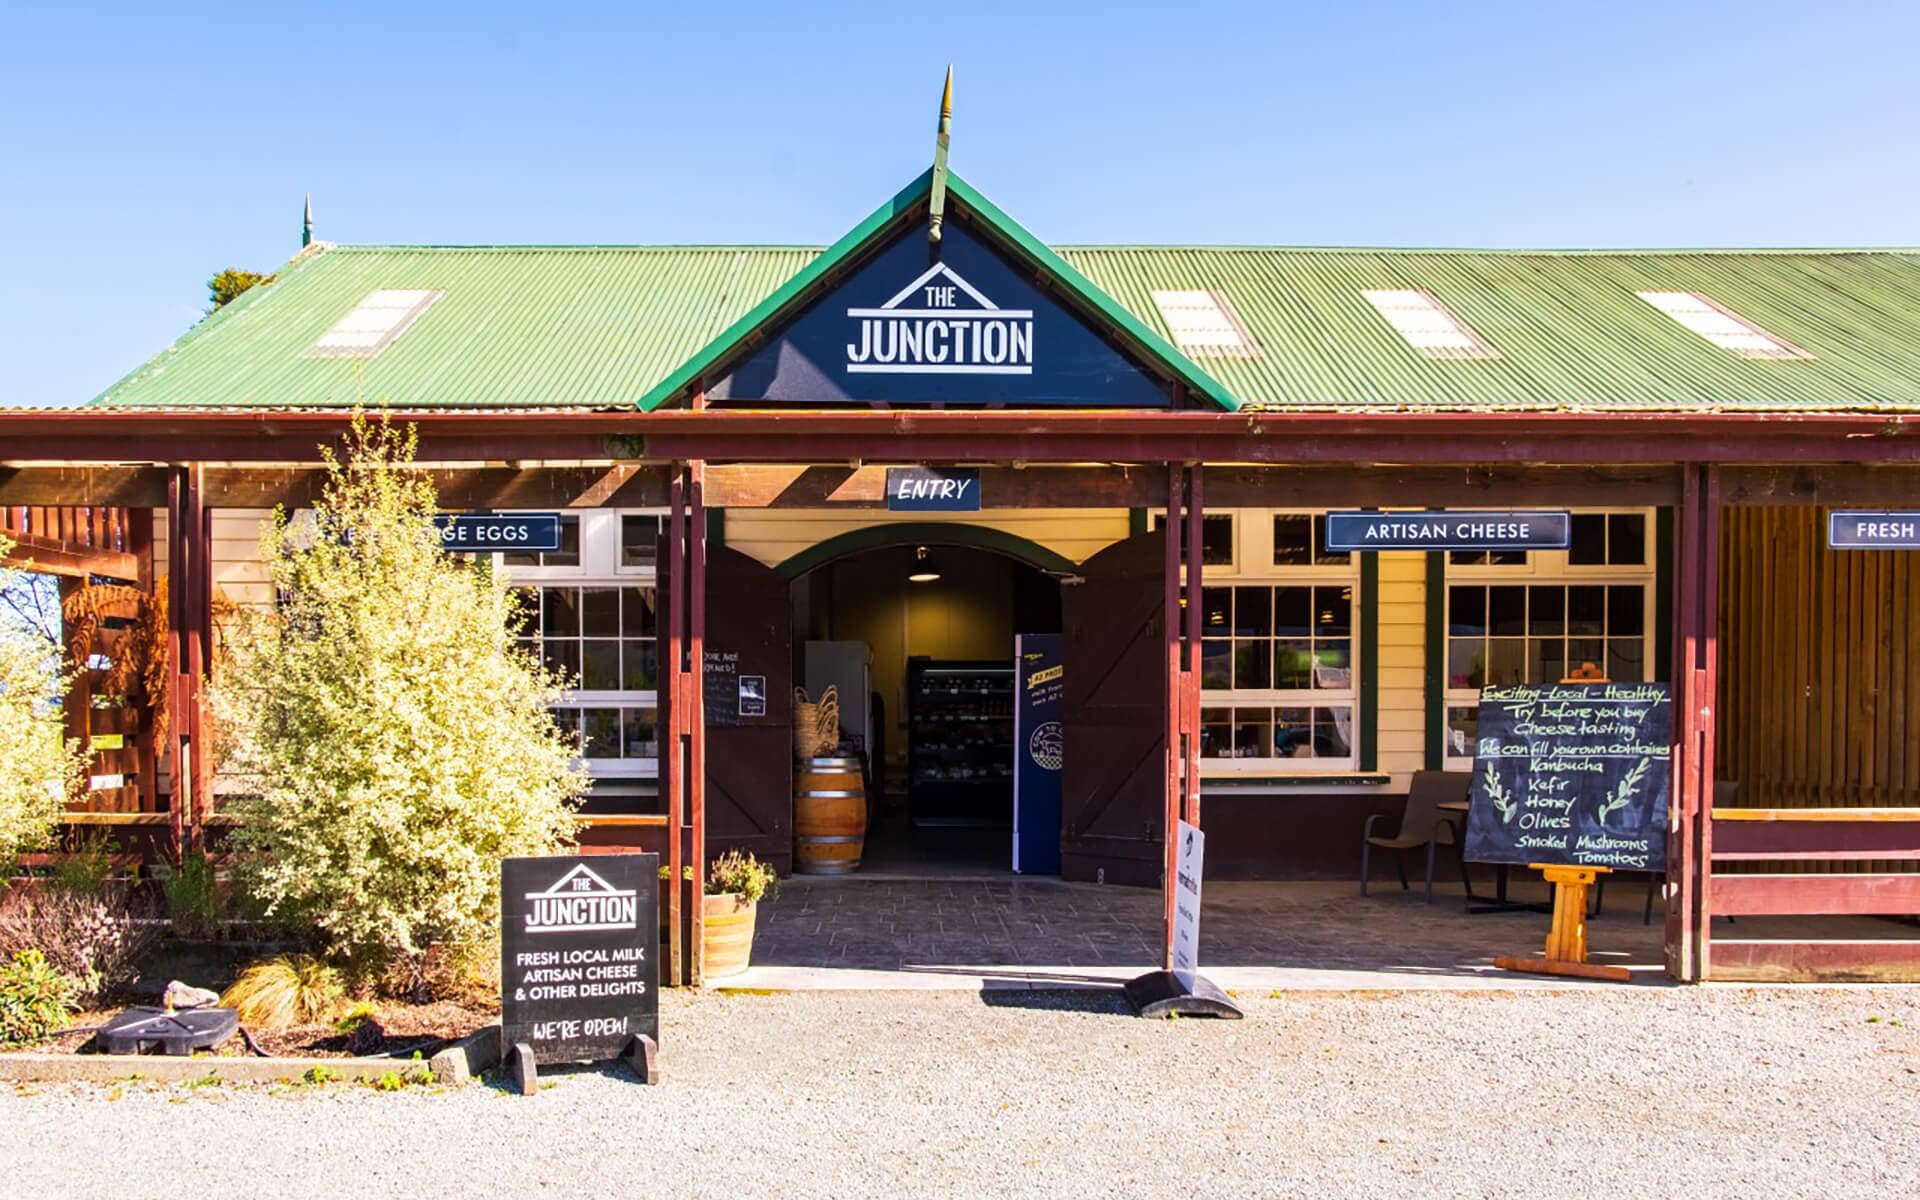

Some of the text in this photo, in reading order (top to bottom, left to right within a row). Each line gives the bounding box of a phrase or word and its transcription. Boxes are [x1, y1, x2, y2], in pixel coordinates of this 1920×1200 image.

[925, 286, 957, 307] THE
[847, 319, 1033, 364] JUNCTION
[897, 478, 971, 499] ENTRY
[476, 525, 528, 541] EGGS
[1365, 523, 1529, 539] ARTISAN CHEESE
[1857, 522, 1914, 538] FRESH
[1604, 685, 1666, 707] Healthy
[1503, 702, 1649, 724] Try before you buy
[1513, 721, 1636, 741] Cheese tasting
[1480, 738, 1500, 754] We
[1502, 745, 1528, 755] can
[1530, 740, 1549, 757] fill
[1528, 776, 1570, 795] Kefir
[1525, 794, 1577, 816] Honey
[1519, 811, 1571, 829] Olives
[1514, 834, 1649, 851] Smoked Mushrooms
[1572, 851, 1649, 868] Tomatoes
[572, 878, 591, 891] THE
[525, 897, 637, 926] JUNCTION
[516, 947, 645, 967] FRESH LOCAL MILK
[523, 964, 637, 983] ARTISAN CHEESE
[515, 981, 645, 1001] & OTHER DELIGHTS
[533, 1020, 581, 1040] WE'RE
